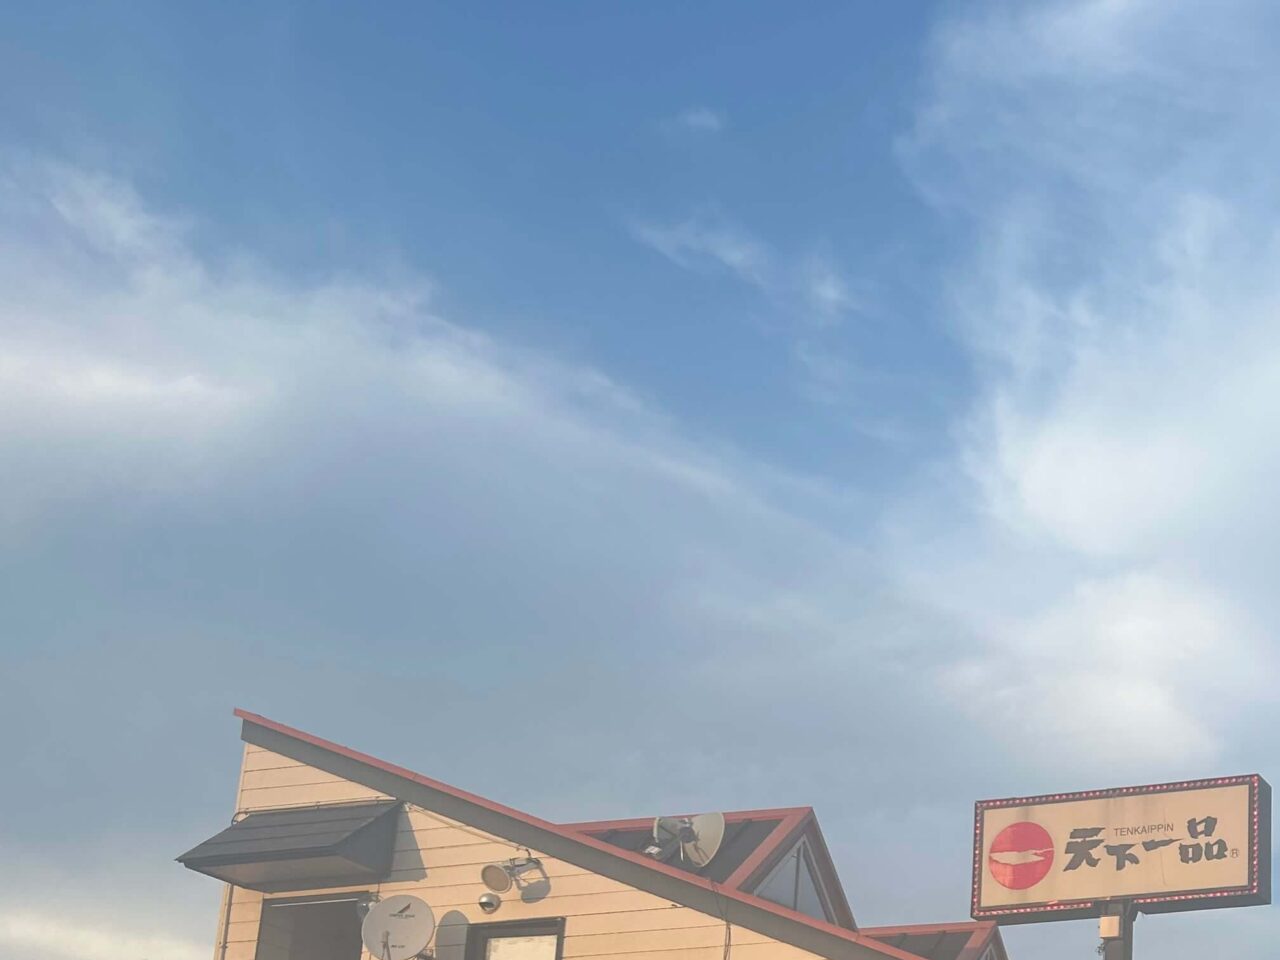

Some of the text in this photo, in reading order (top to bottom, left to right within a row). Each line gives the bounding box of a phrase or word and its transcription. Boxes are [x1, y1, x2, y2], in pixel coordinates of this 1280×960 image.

[1063, 815, 1229, 872] 天下一品
[1113, 823, 1175, 837] TENKAIPPIN
